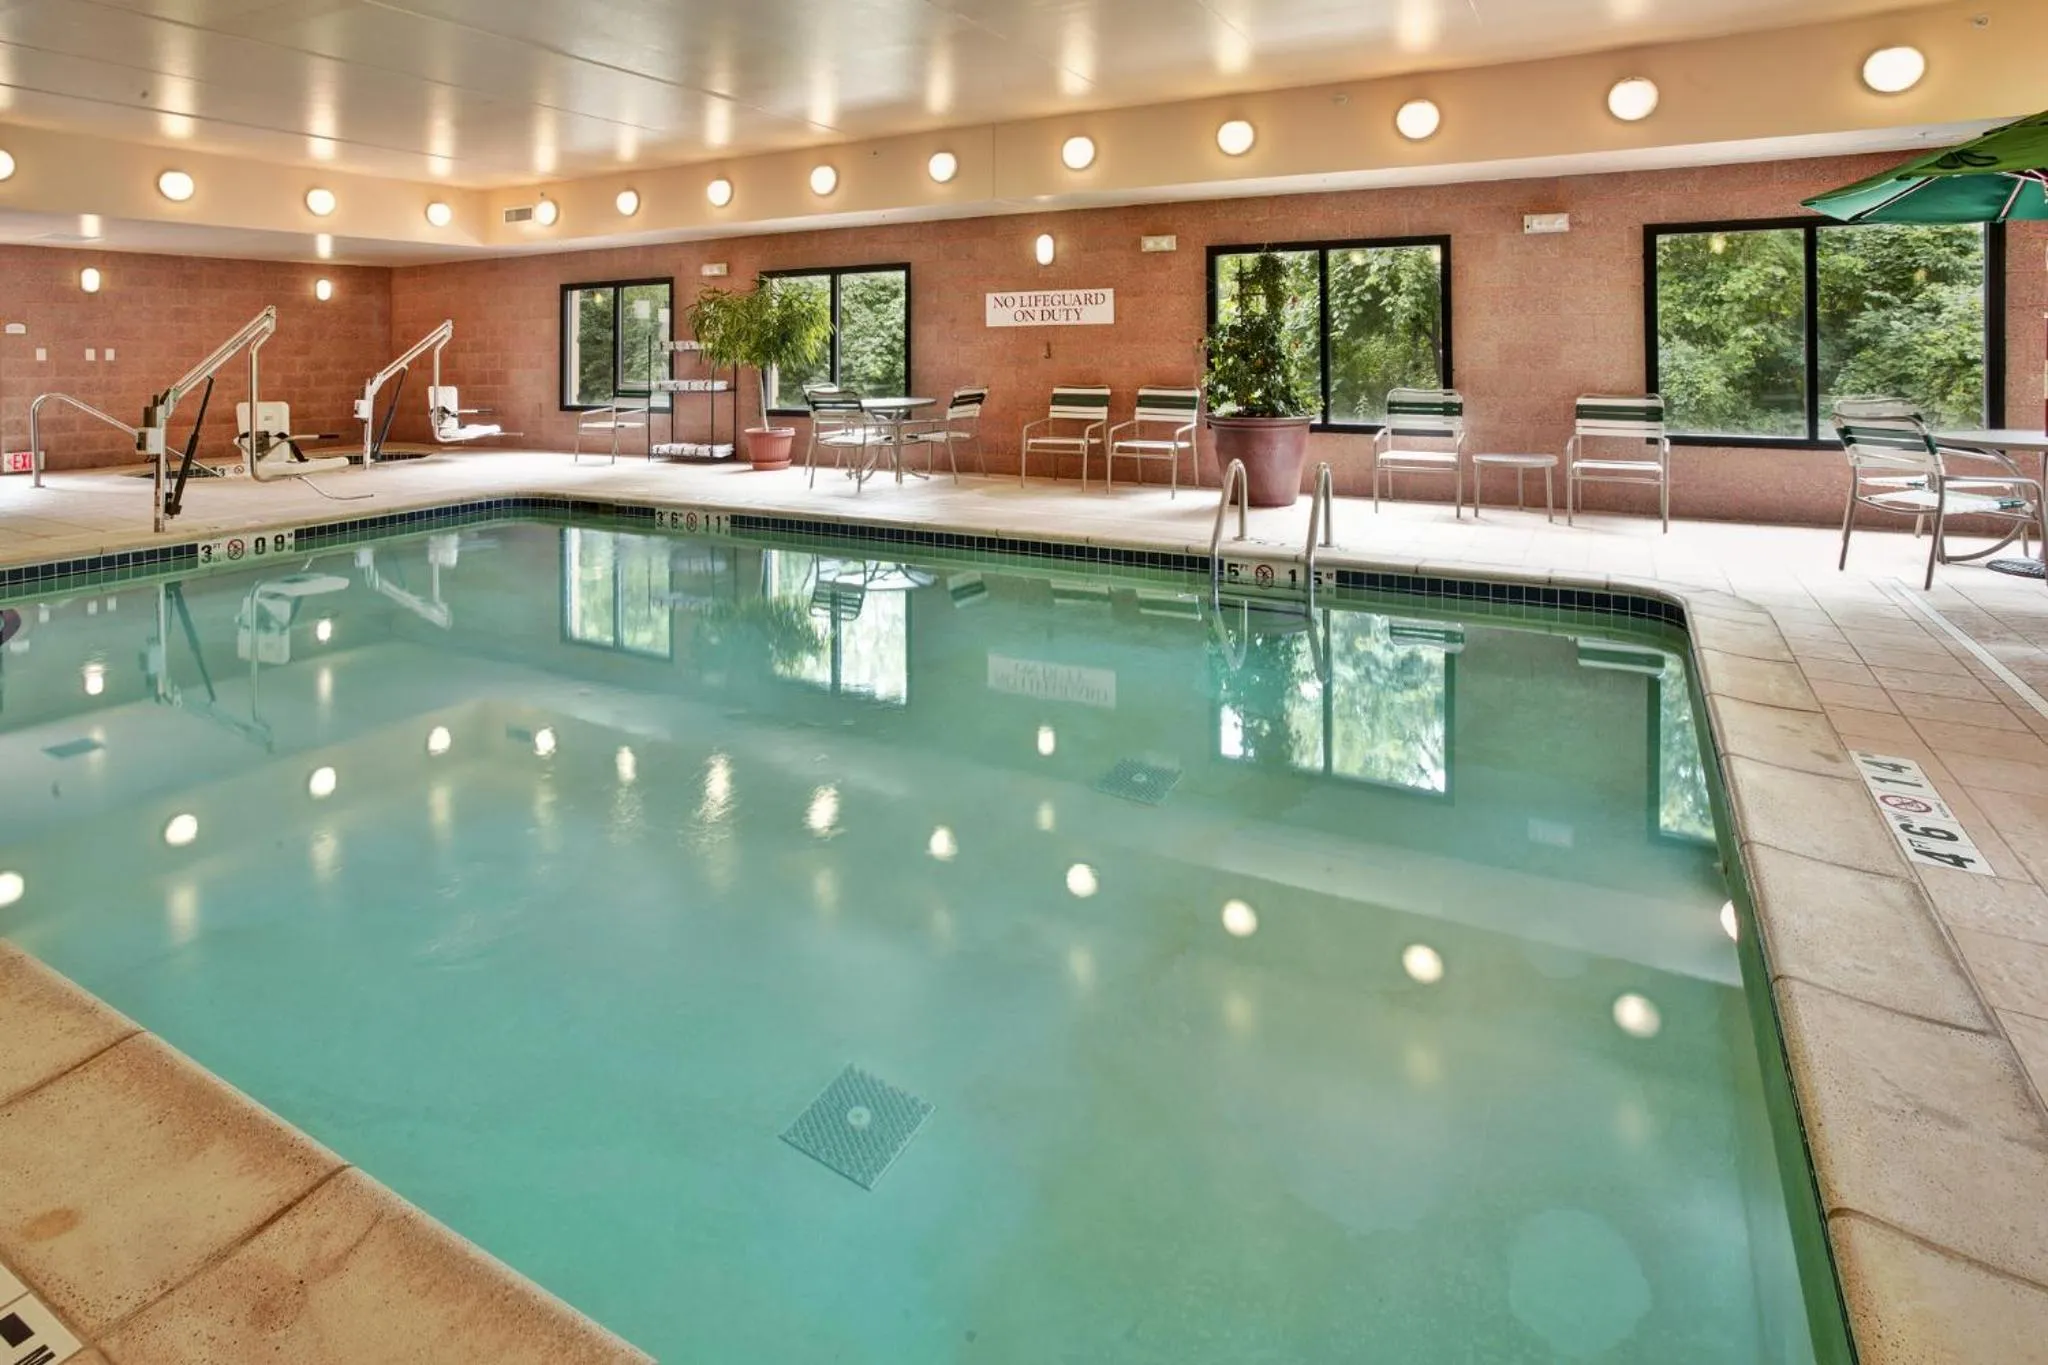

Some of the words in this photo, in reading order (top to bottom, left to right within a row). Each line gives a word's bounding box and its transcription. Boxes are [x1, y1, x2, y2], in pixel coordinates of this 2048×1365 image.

[993, 295, 1015, 309] NO
[1020, 293, 1106, 308] LIFEGUARD
[1014, 309, 1035, 322] ON
[1041, 308, 1083, 321] DUTY
[13, 453, 34, 470] EXI
